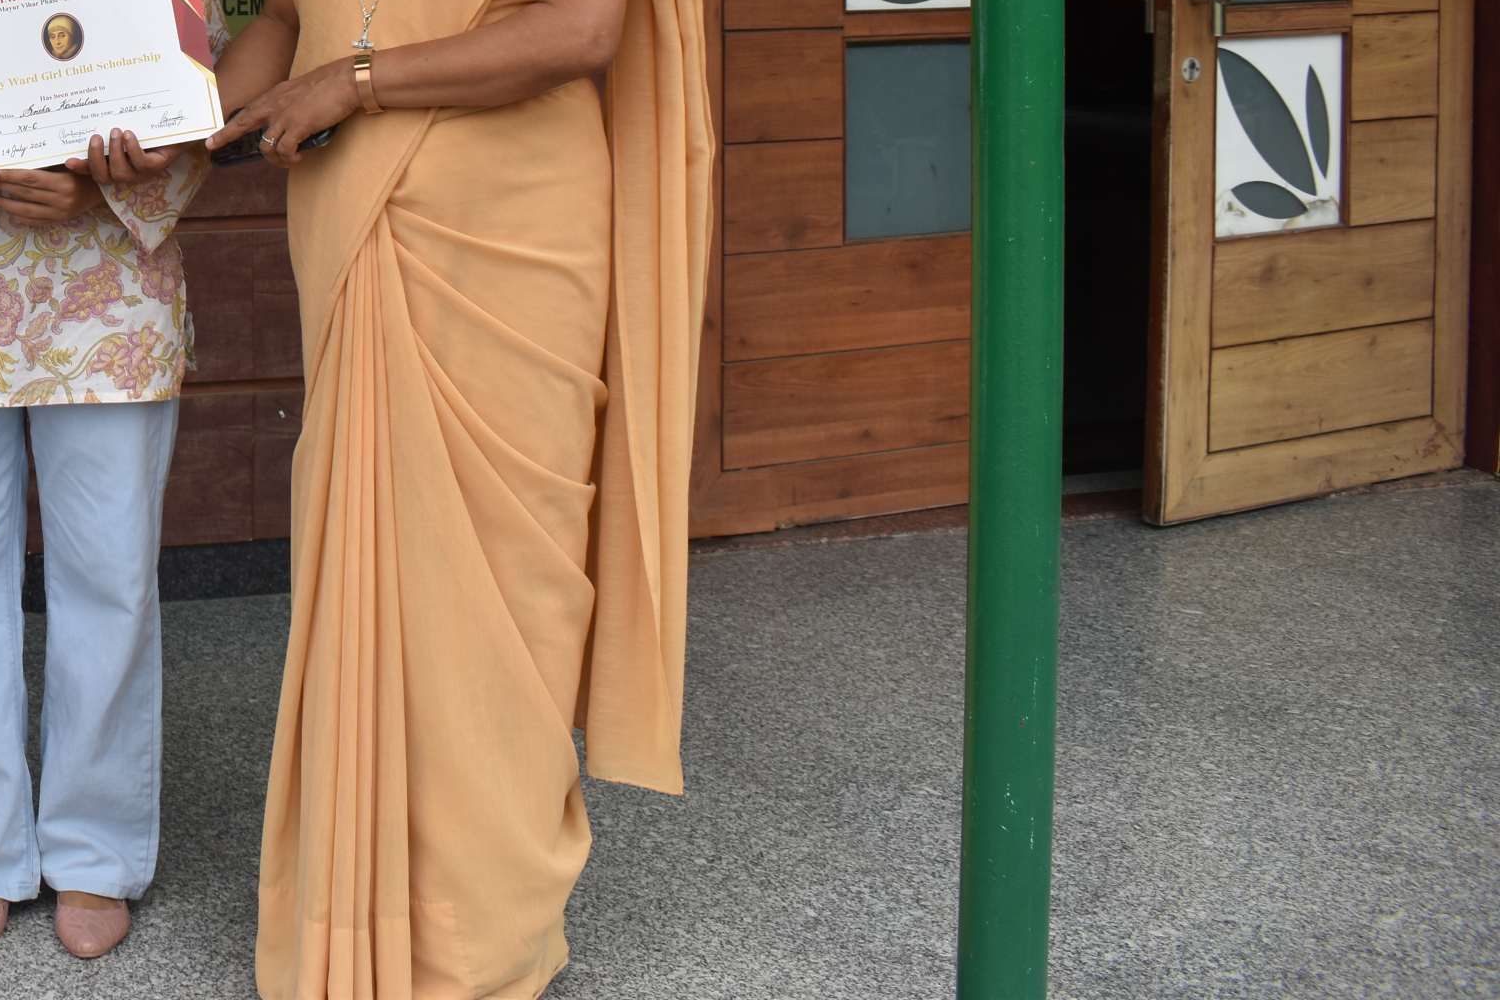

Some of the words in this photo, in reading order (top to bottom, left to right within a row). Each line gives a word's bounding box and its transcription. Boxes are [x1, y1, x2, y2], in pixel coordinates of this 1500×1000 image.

[21, 0, 39, 9] Vihar
[7, 73, 38, 87] Ward
[41, 69, 63, 81] Girl
[65, 63, 93, 77] Child
[96, 52, 161, 72] Scholarship
